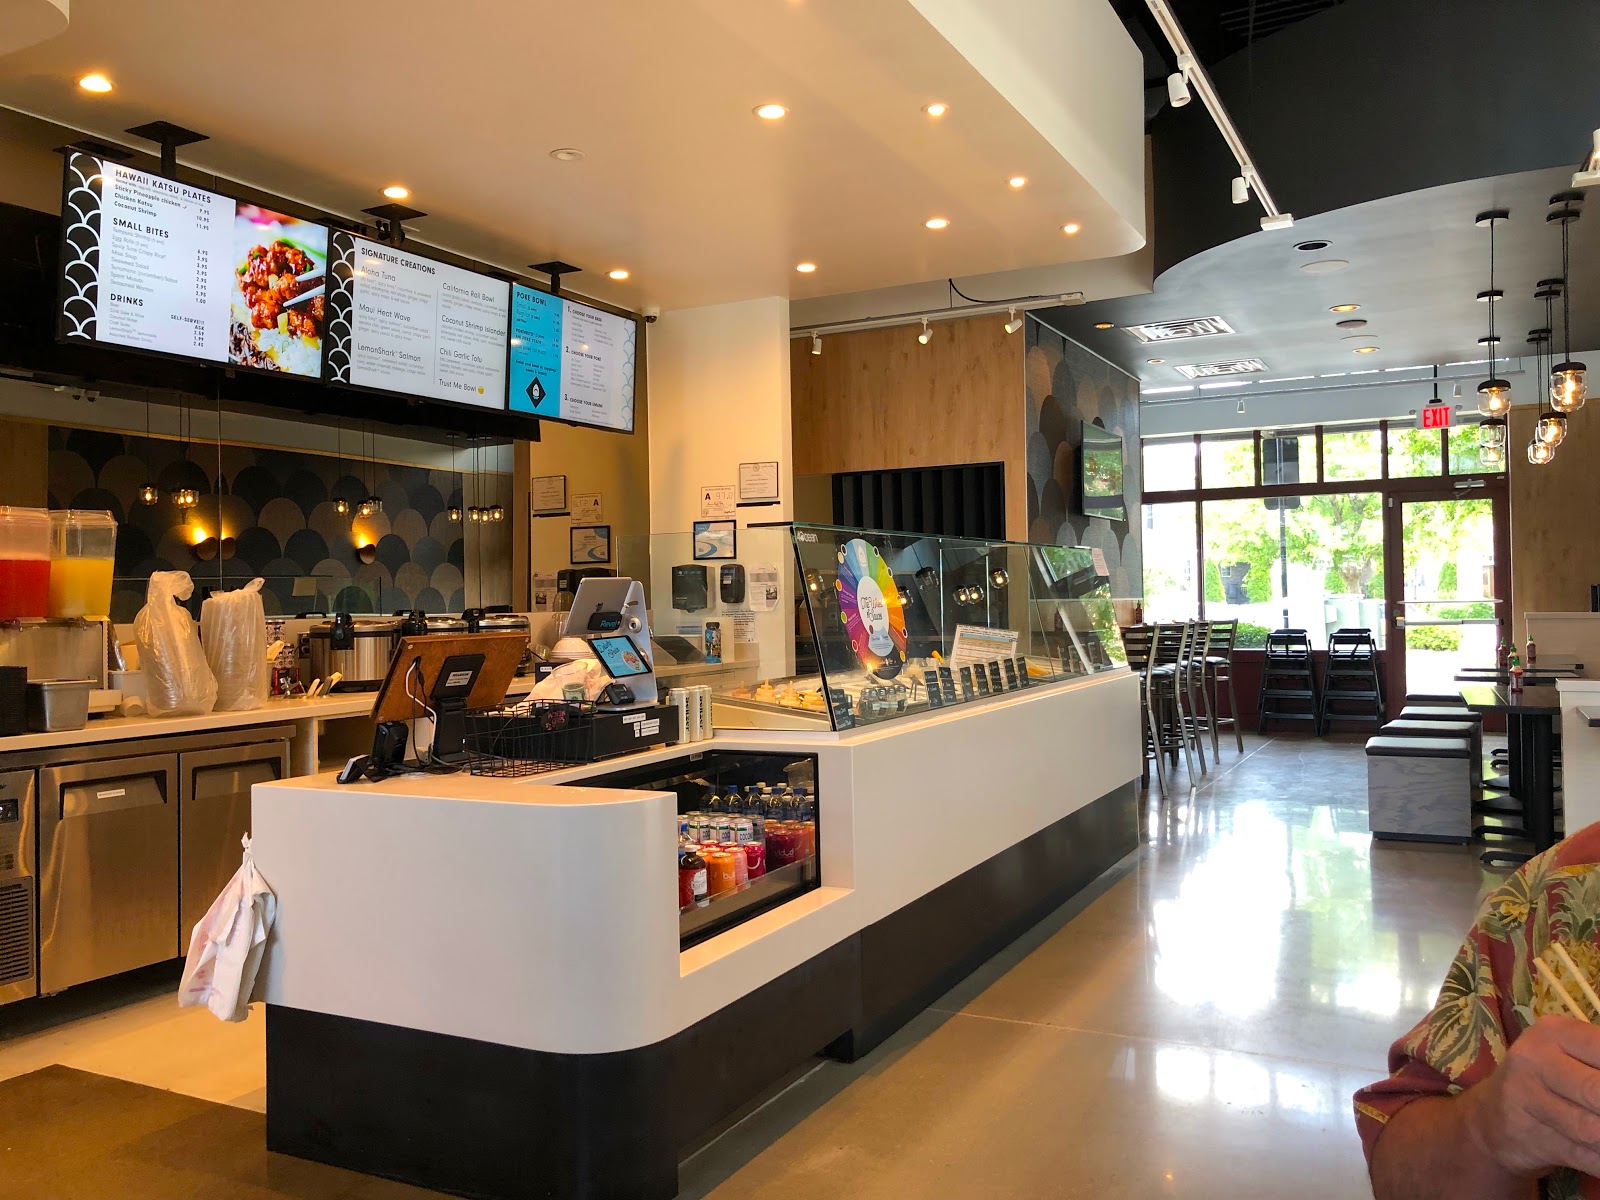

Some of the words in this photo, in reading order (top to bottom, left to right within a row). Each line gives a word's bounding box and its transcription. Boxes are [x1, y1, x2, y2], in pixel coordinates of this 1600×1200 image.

[116, 169, 148, 185] HAWAII
[153, 180, 179, 194] KATSU
[183, 189, 211, 204] PLATES
[115, 184, 131, 194] Sticky
[134, 189, 160, 202] Pineapple
[161, 197, 180, 208] chicken
[115, 192, 136, 203] Chicken
[138, 199, 153, 207] Katsu
[114, 200, 136, 212] Coconut
[138, 207, 157, 217] Shrimp
[113, 217, 142, 232] SMALL
[146, 226, 169, 238] BITES
[361, 247, 399, 265] SIGNATURE
[401, 259, 435, 275] CREATIONS
[361, 265, 379, 277] Aloha
[382, 271, 396, 282] Tuna
[111, 293, 143, 306] DRINKS
[443, 282, 469, 296] California
[471, 290, 480, 299] Roll
[482, 294, 494, 303] Bowl
[517, 291, 530, 302] POKE
[532, 296, 547, 306] BOWL
[359, 303, 375, 314] Maui
[377, 308, 392, 318] Heat
[394, 312, 410, 322] Wave
[442, 315, 463, 327] Coconut
[465, 321, 483, 332] Shrimp
[485, 326, 505, 337] Islander
[399, 351, 420, 362] Salmon
[440, 348, 451, 356] Chili
[454, 351, 469, 360] Garlic
[472, 355, 482, 363] Tofu
[439, 379, 451, 387] Trust
[464, 384, 476, 392] Bowl
[1423, 406, 1450, 428] EXIT
